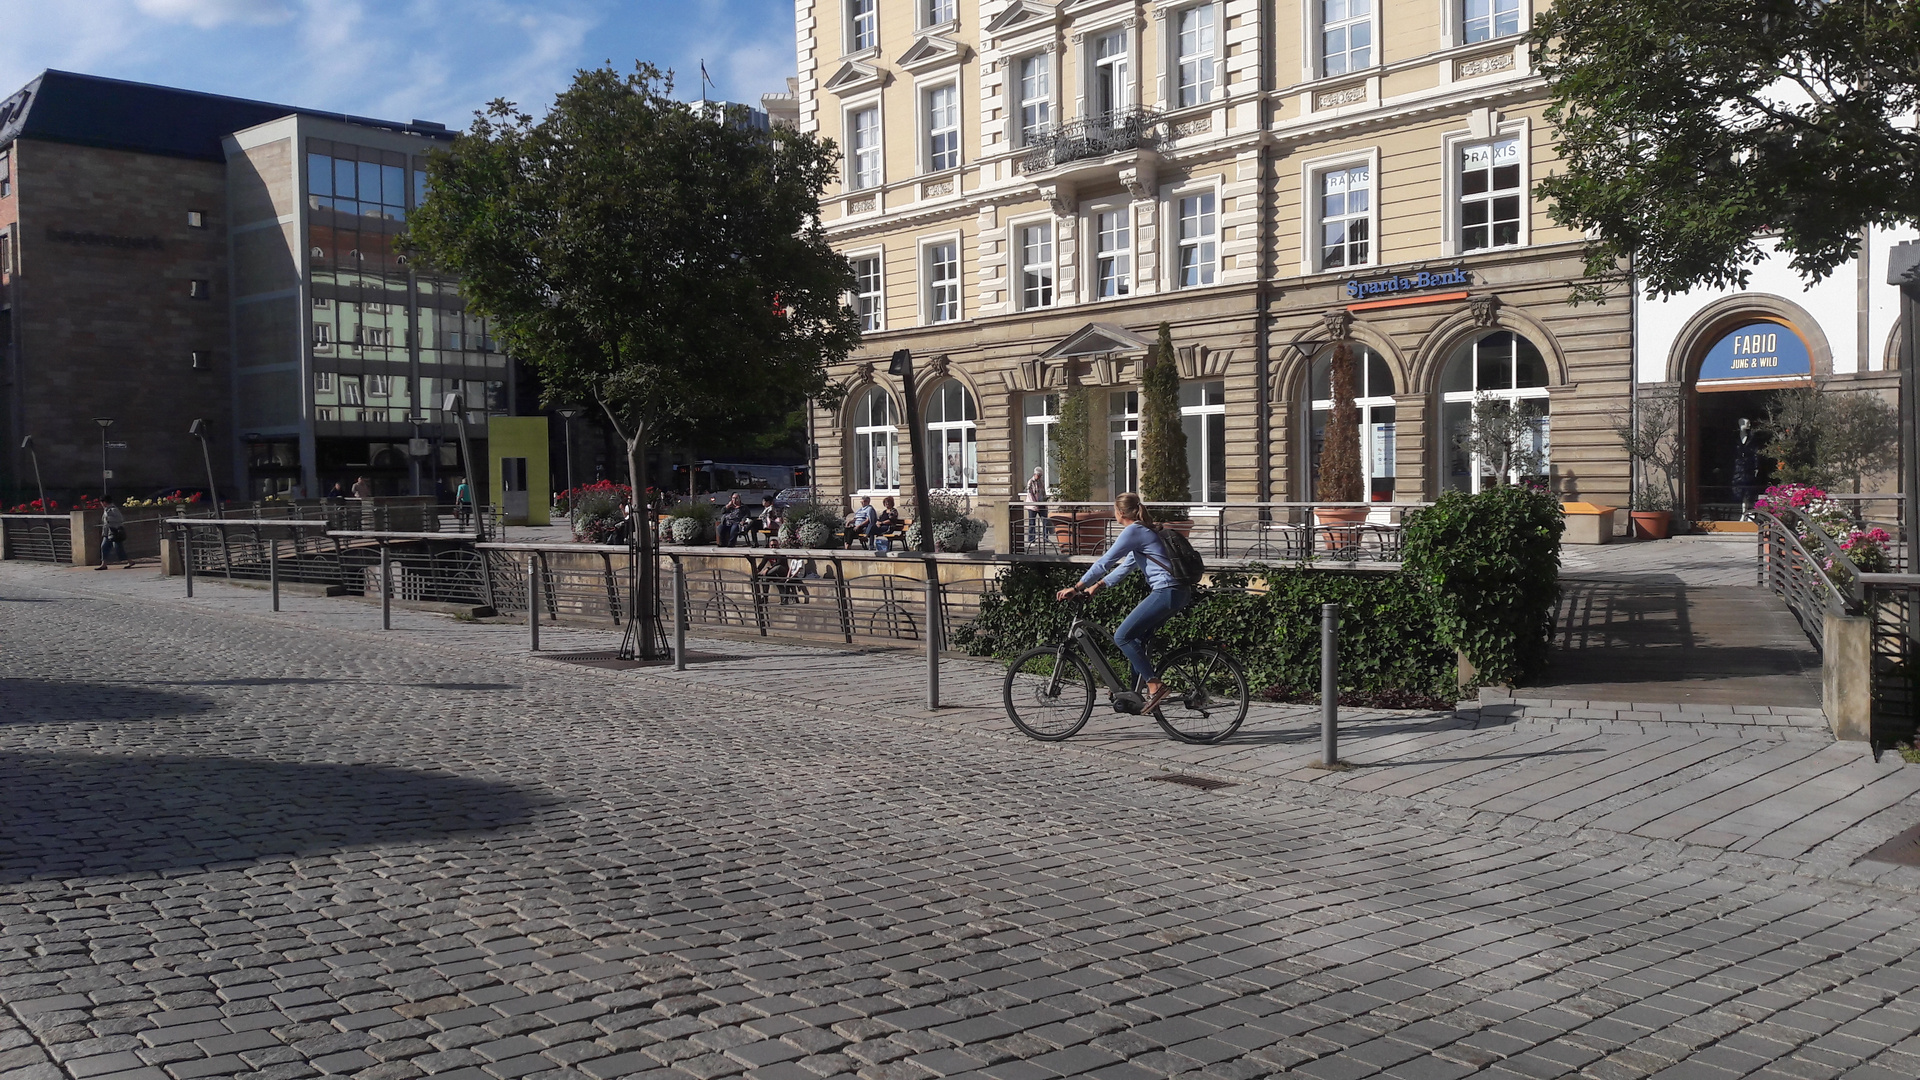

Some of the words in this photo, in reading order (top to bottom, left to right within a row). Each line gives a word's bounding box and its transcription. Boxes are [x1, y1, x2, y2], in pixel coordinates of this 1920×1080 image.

[1464, 145, 1516, 163] PRAXIS
[1346, 268, 1468, 299] Sparda-Bank
[1734, 333, 1777, 355] FABIO
[1730, 358, 1750, 369] JUNG
[1751, 357, 1758, 368] &
[1759, 356, 1778, 368] WILD
